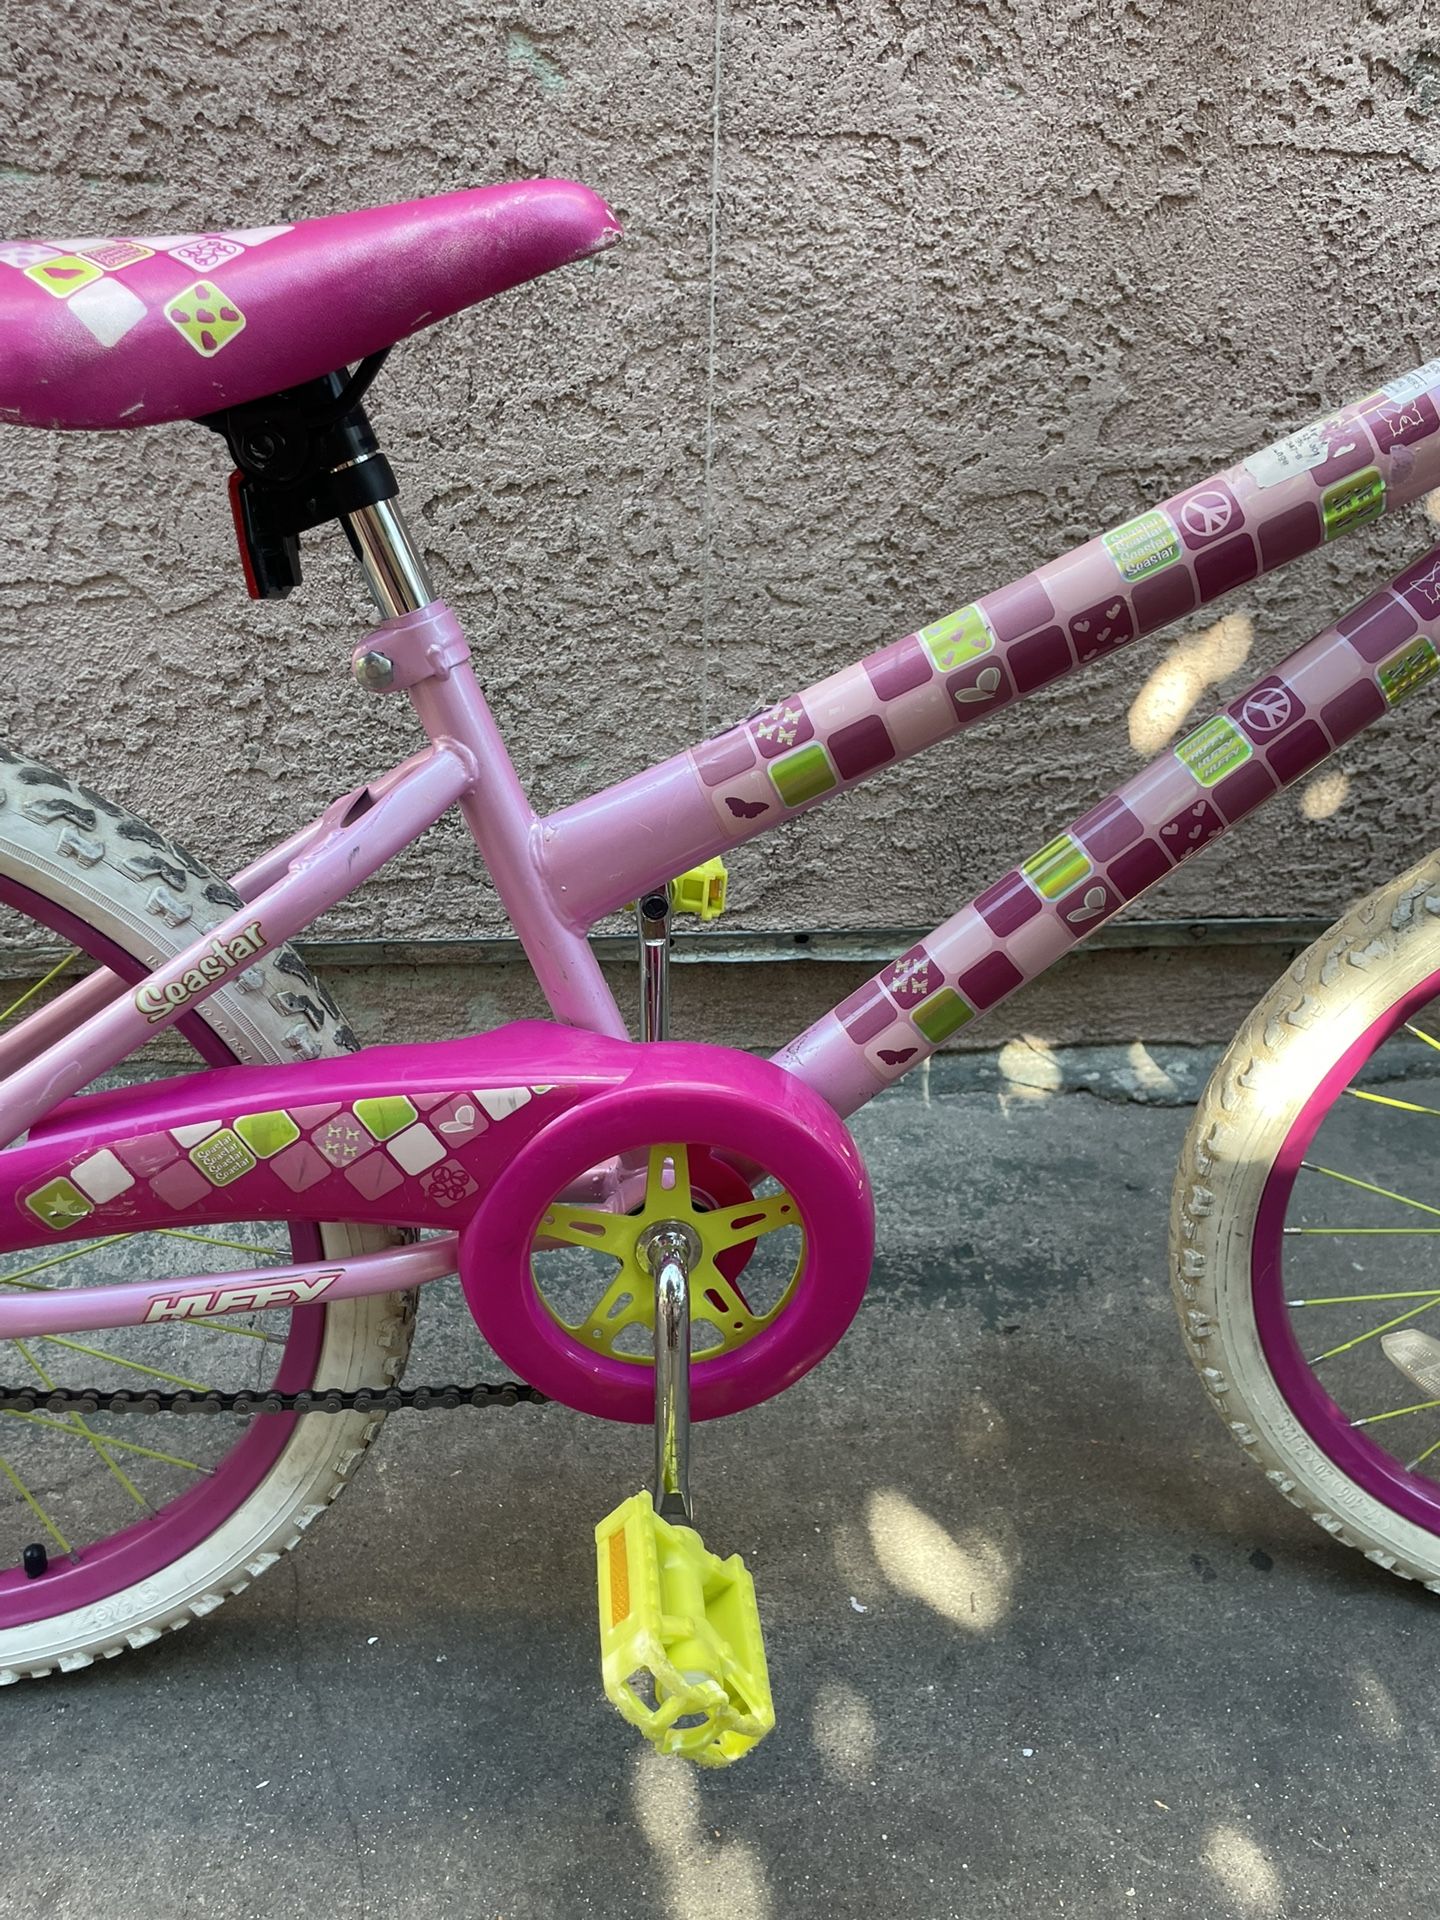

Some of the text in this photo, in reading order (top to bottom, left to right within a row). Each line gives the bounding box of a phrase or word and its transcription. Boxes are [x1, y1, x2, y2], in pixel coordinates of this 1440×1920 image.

[1125, 545, 1175, 576] Seastar
[135, 921, 267, 1024] Seastar
[143, 1271, 343, 1324] HUFFY
